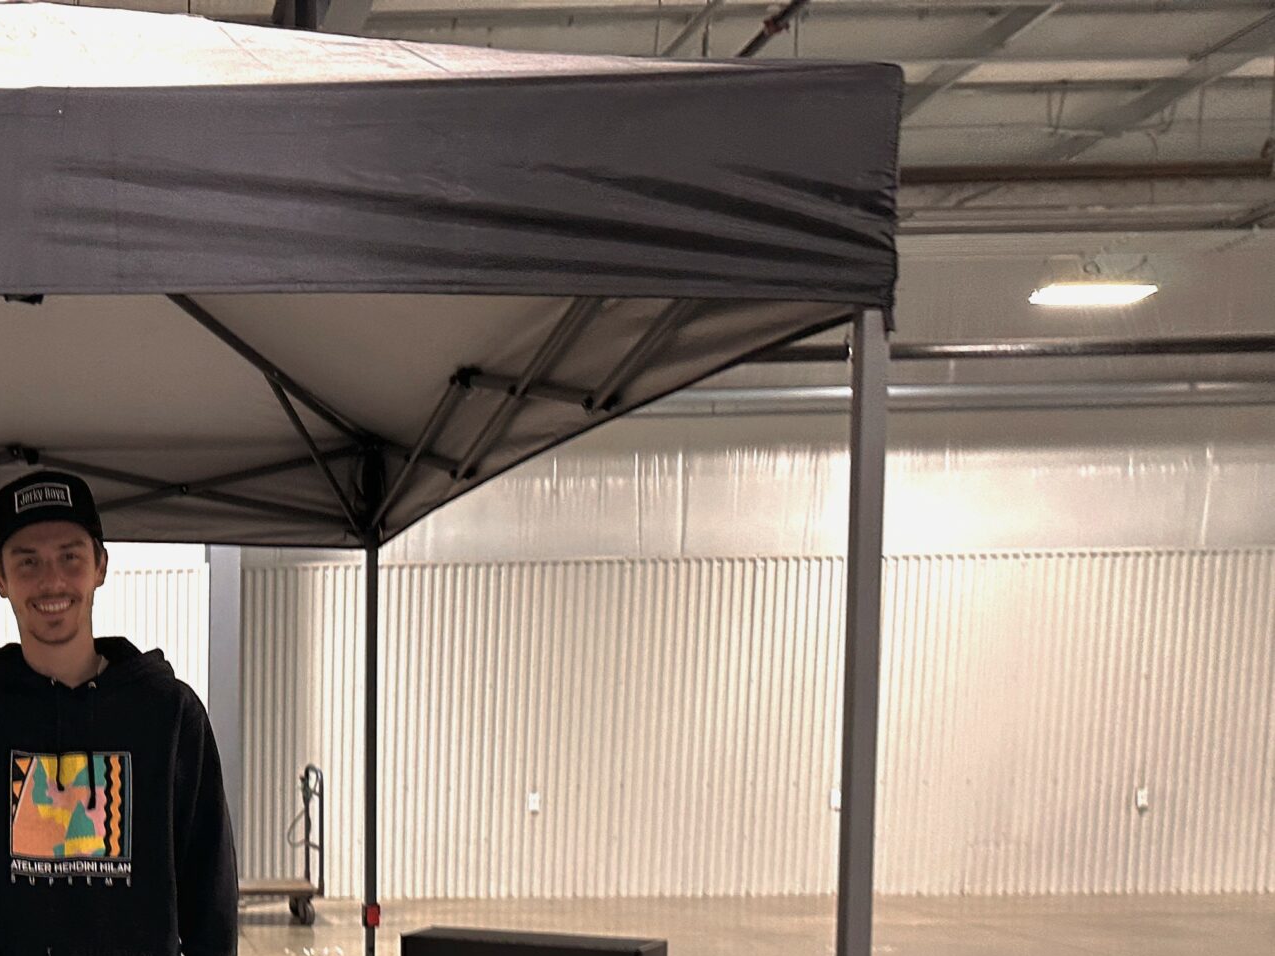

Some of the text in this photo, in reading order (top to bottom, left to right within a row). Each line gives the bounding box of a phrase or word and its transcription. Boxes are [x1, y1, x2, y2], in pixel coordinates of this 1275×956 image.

[10, 859, 131, 873] ATELIER MENDINI MILAN
